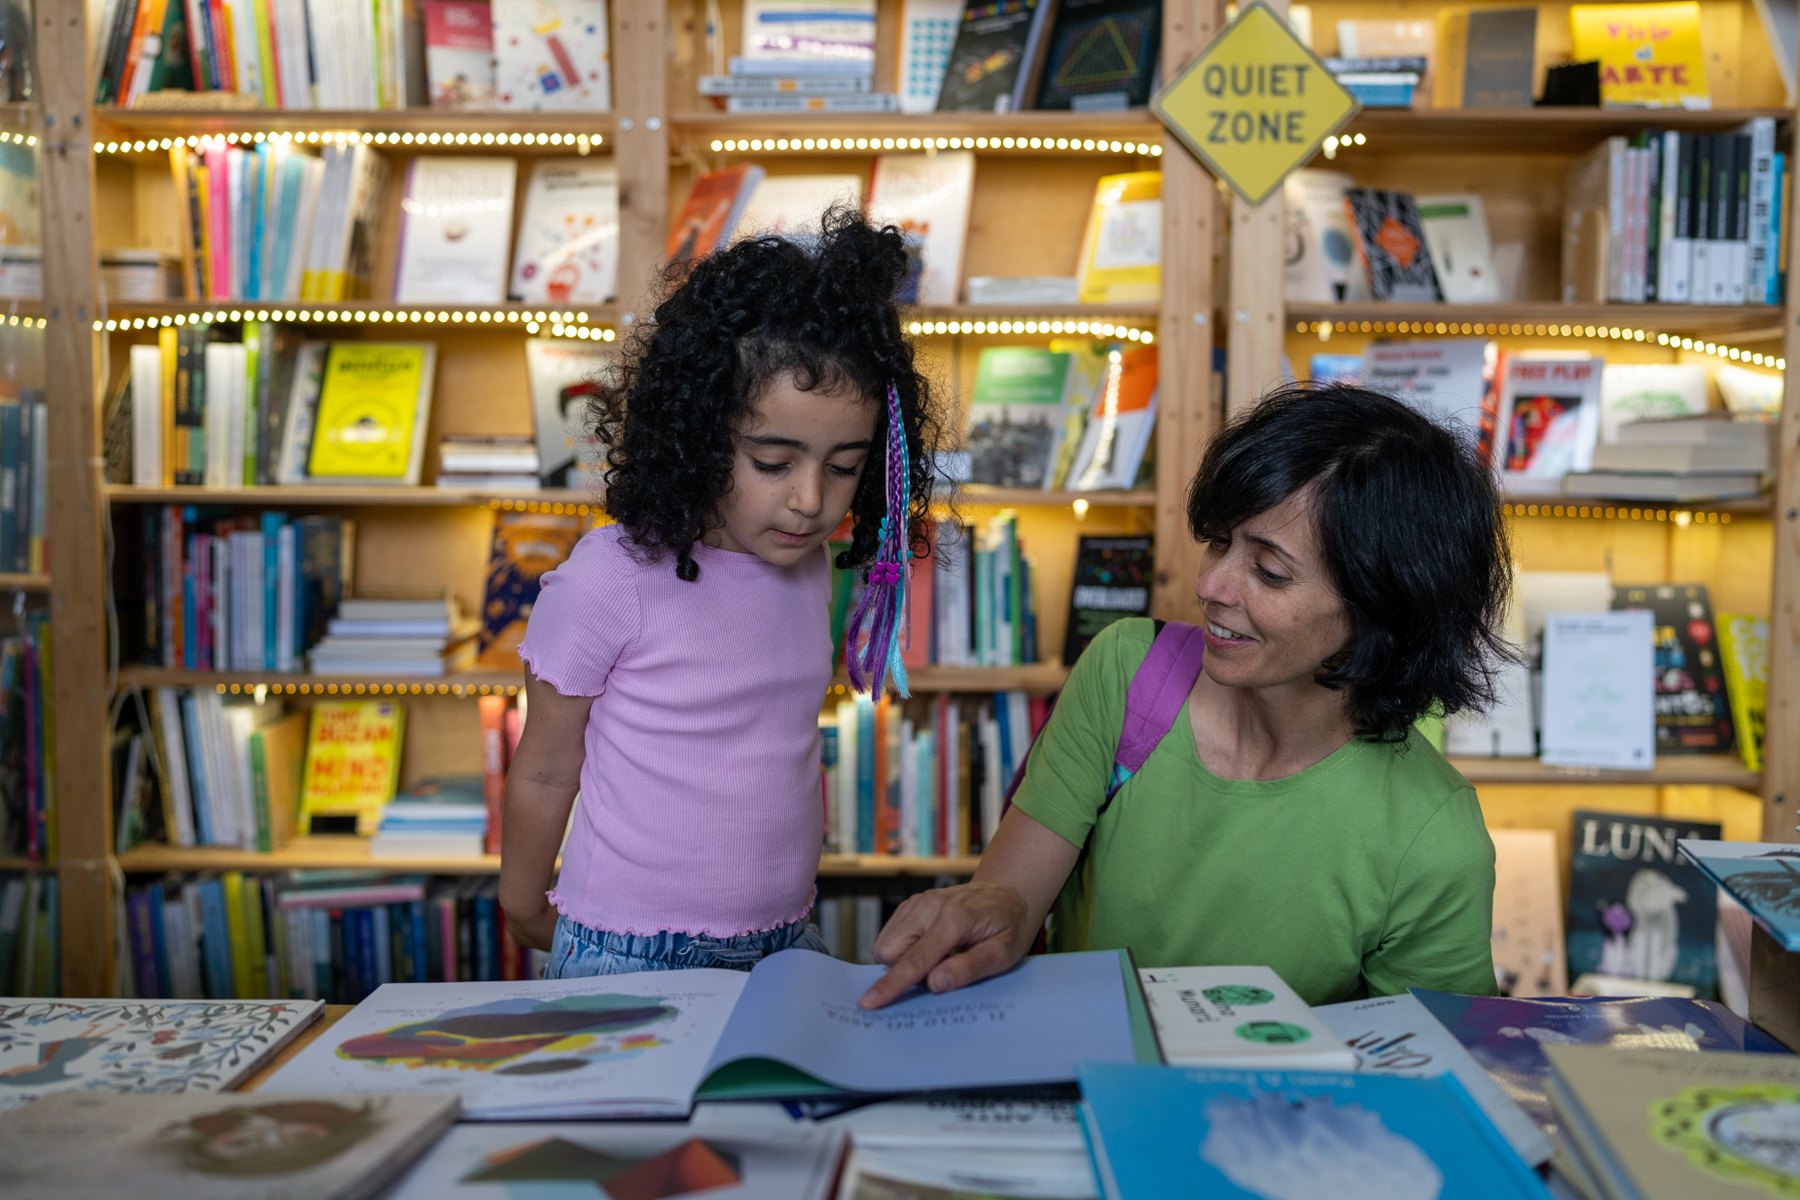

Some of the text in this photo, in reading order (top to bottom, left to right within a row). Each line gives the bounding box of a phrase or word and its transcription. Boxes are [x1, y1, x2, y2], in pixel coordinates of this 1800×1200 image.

[1203, 63, 1309, 98] QUIET
[1601, 64, 1688, 86] ARTE
[1207, 110, 1306, 144] ZONE
[1511, 364, 1594, 382] FREE PLAY
